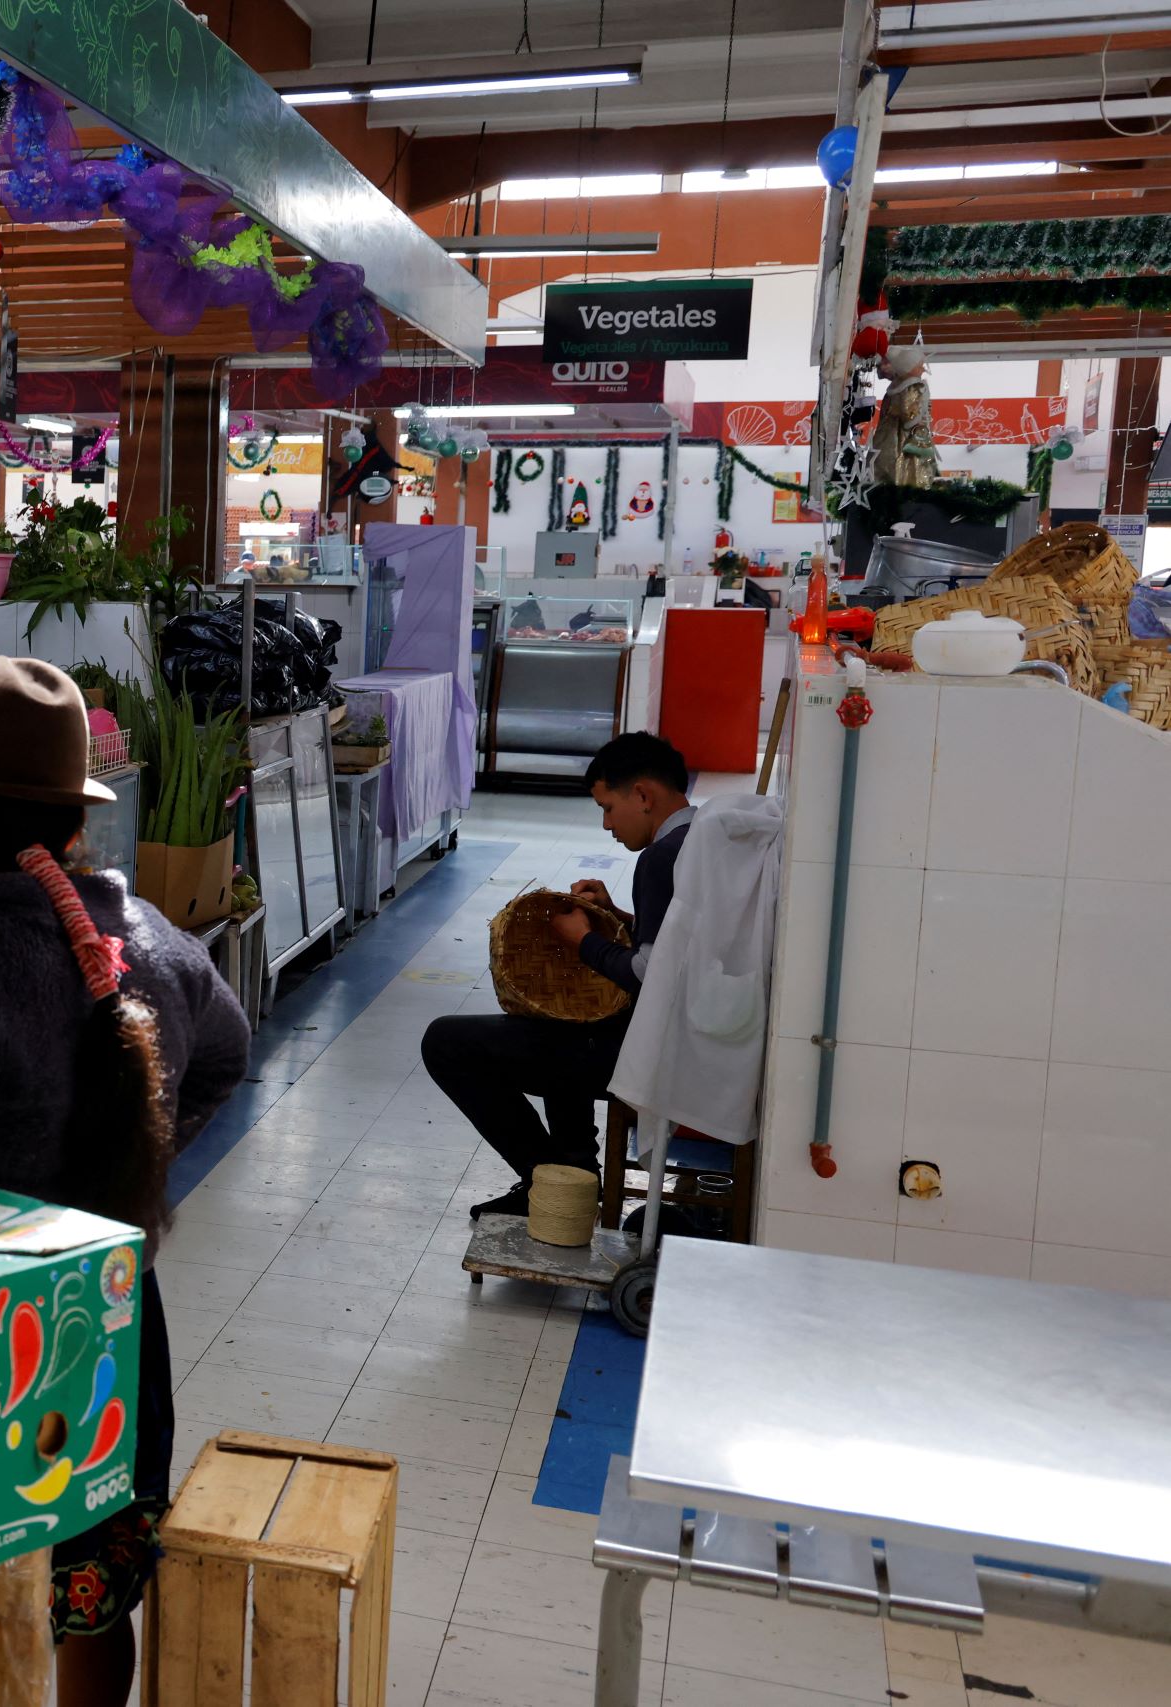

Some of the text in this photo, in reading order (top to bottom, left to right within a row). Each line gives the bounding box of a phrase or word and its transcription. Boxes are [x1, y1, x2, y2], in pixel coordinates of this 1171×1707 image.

[578, 304, 717, 335] Vegetales
[651, 339, 729, 357] Yuyukuna
[552, 361, 630, 381] QUITO
